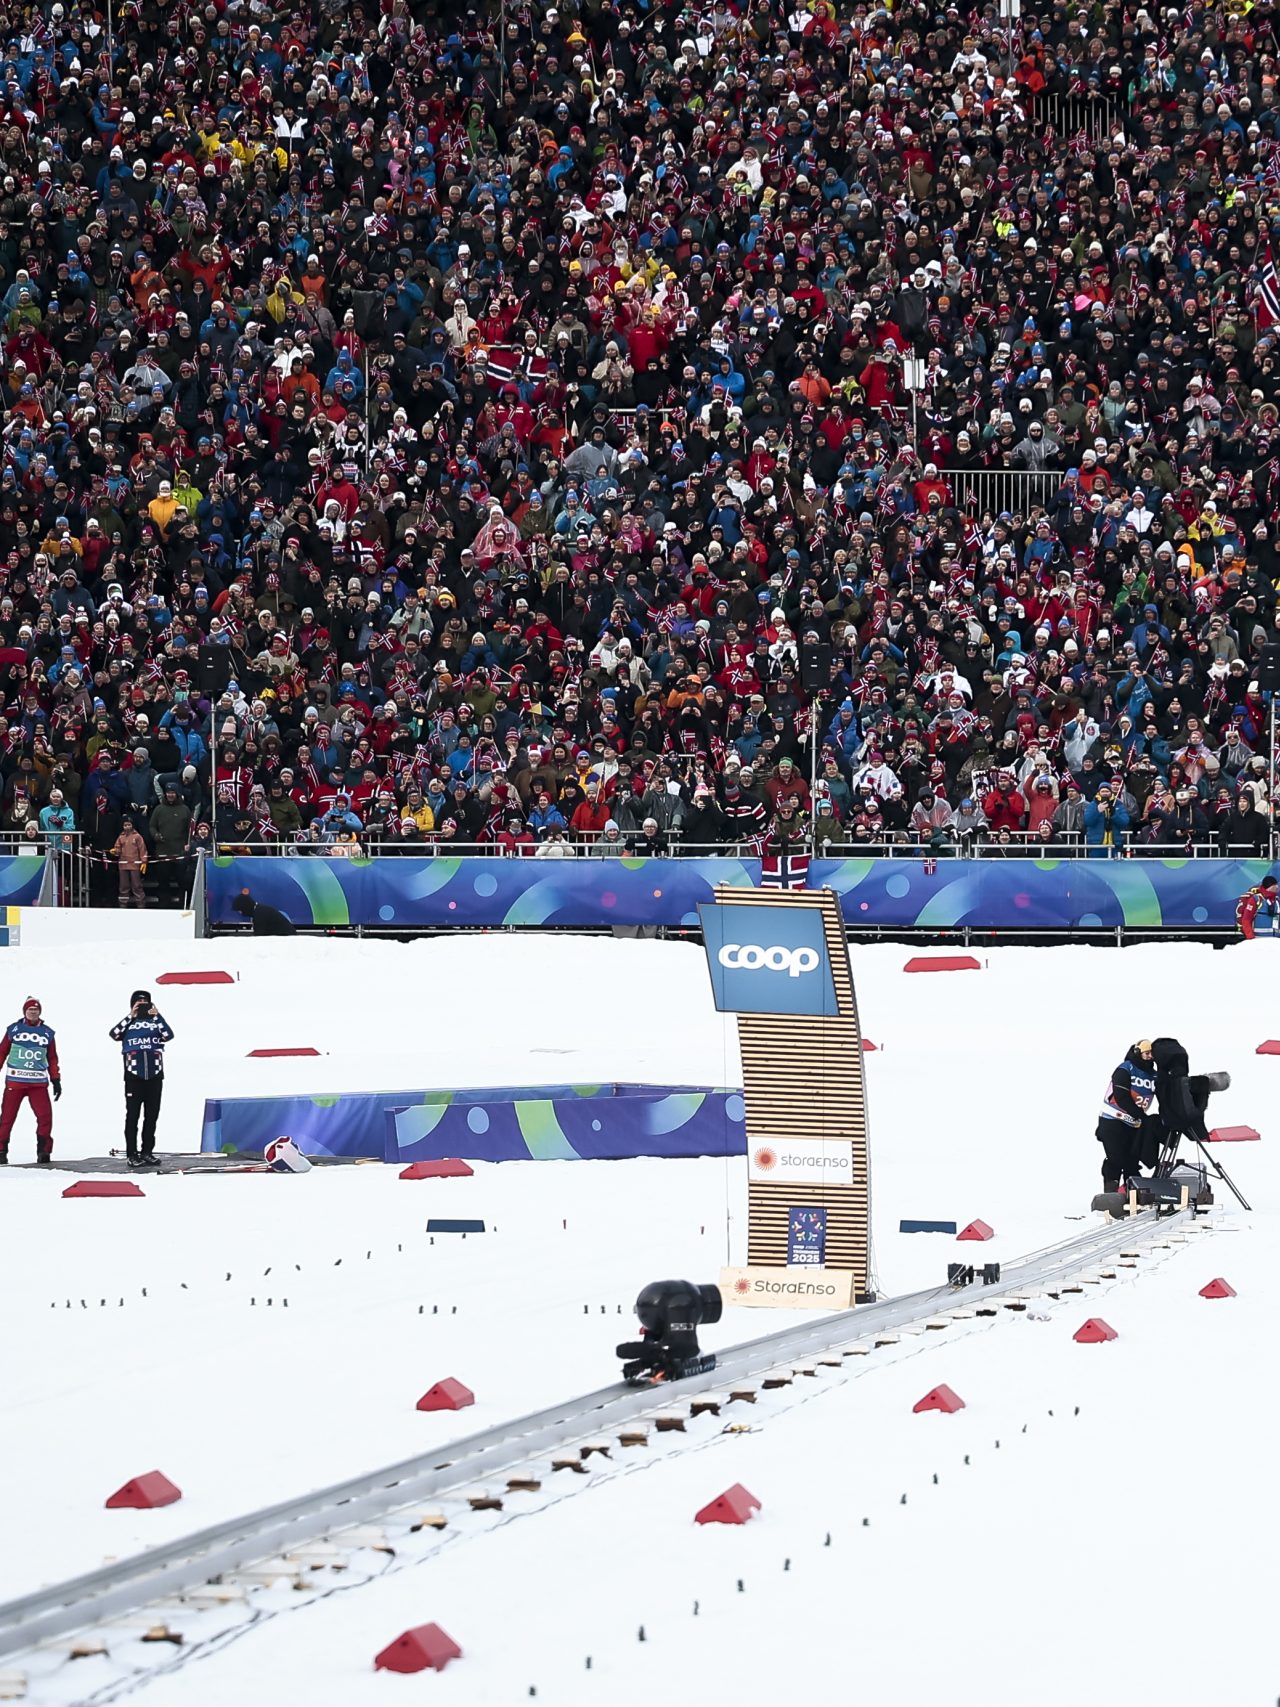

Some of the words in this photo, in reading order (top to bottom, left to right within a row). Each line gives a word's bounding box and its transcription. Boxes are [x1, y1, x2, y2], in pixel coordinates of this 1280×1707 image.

[718, 943, 820, 978] coop
[12, 1032, 49, 1046] coop
[127, 1036, 151, 1046] TEAM
[18, 1049, 42, 1060] LOC
[23, 1061, 35, 1069] 42
[1135, 1095, 1150, 1109] 25
[792, 1253, 820, 1263] 2025
[754, 1280, 836, 1296] StoraEnso
